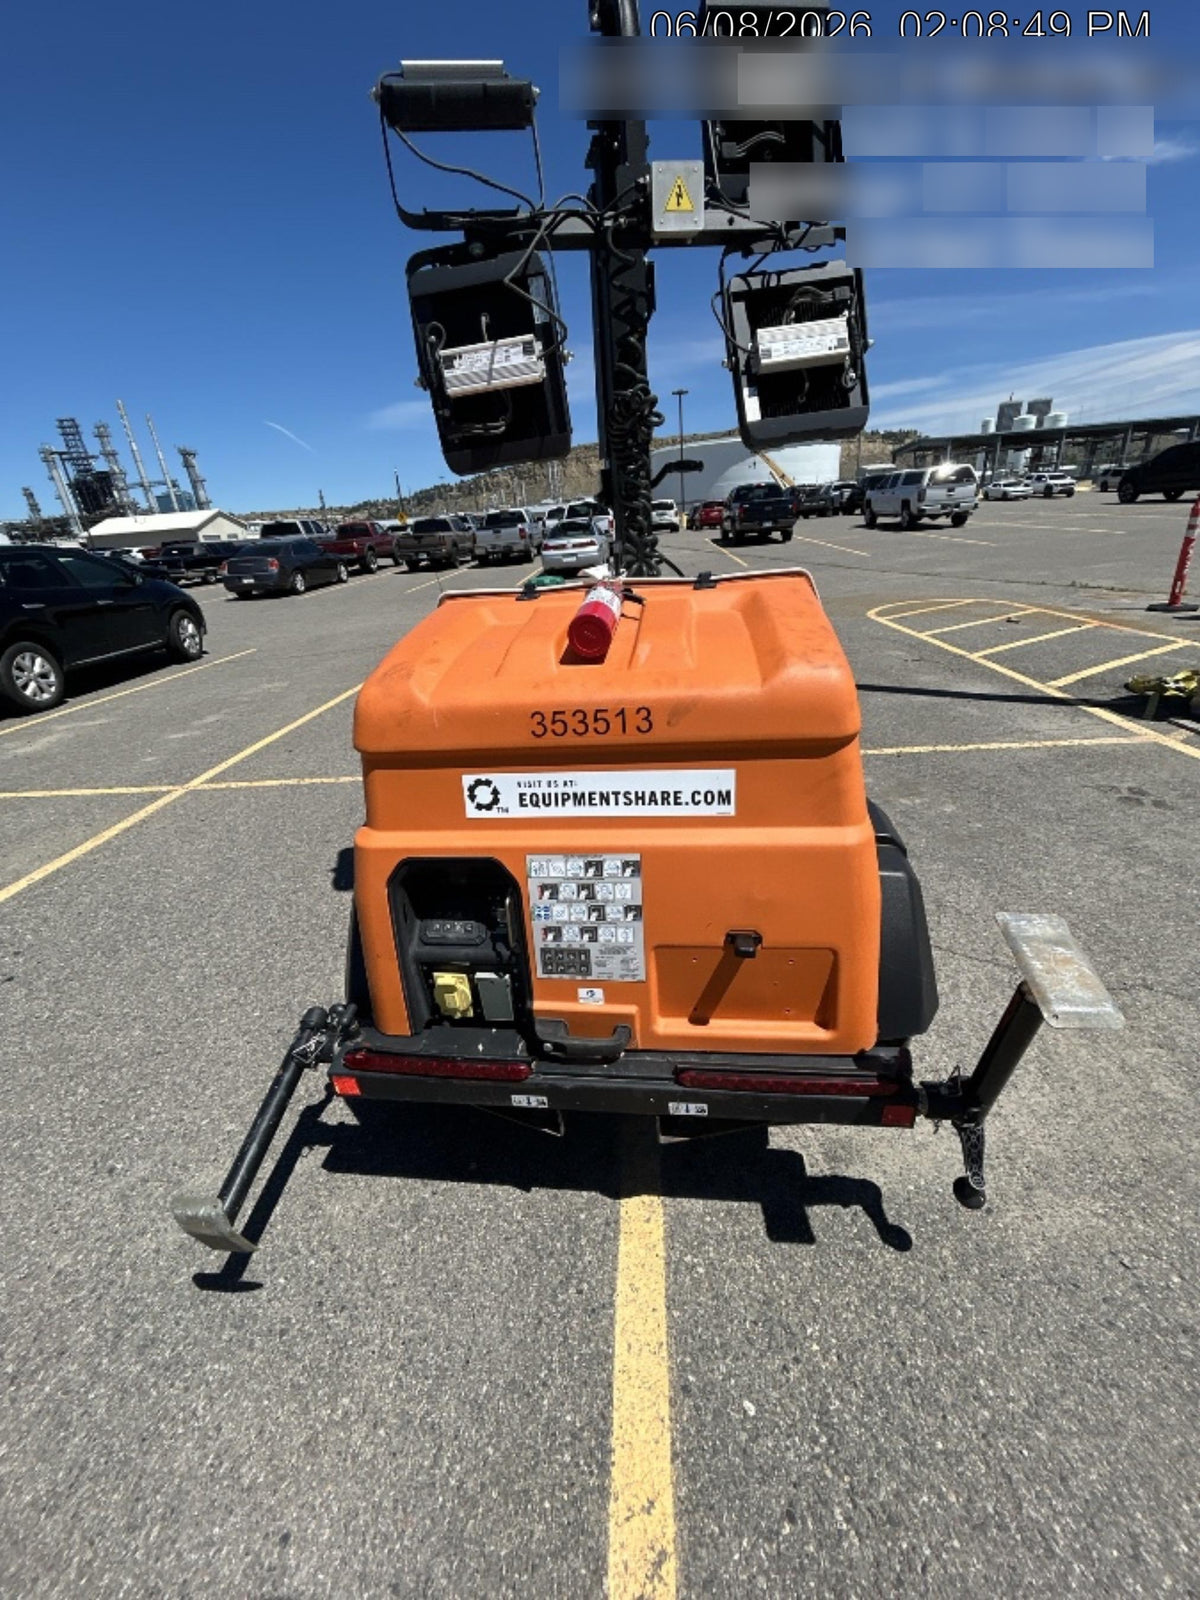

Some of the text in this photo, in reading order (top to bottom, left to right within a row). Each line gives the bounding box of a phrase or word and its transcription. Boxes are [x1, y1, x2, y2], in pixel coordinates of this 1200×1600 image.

[530, 706, 653, 738] 353513
[517, 780, 542, 788] VISIT
[547, 780, 559, 788] US
[518, 789, 732, 809] EQUIPMENTSHARE.COM
